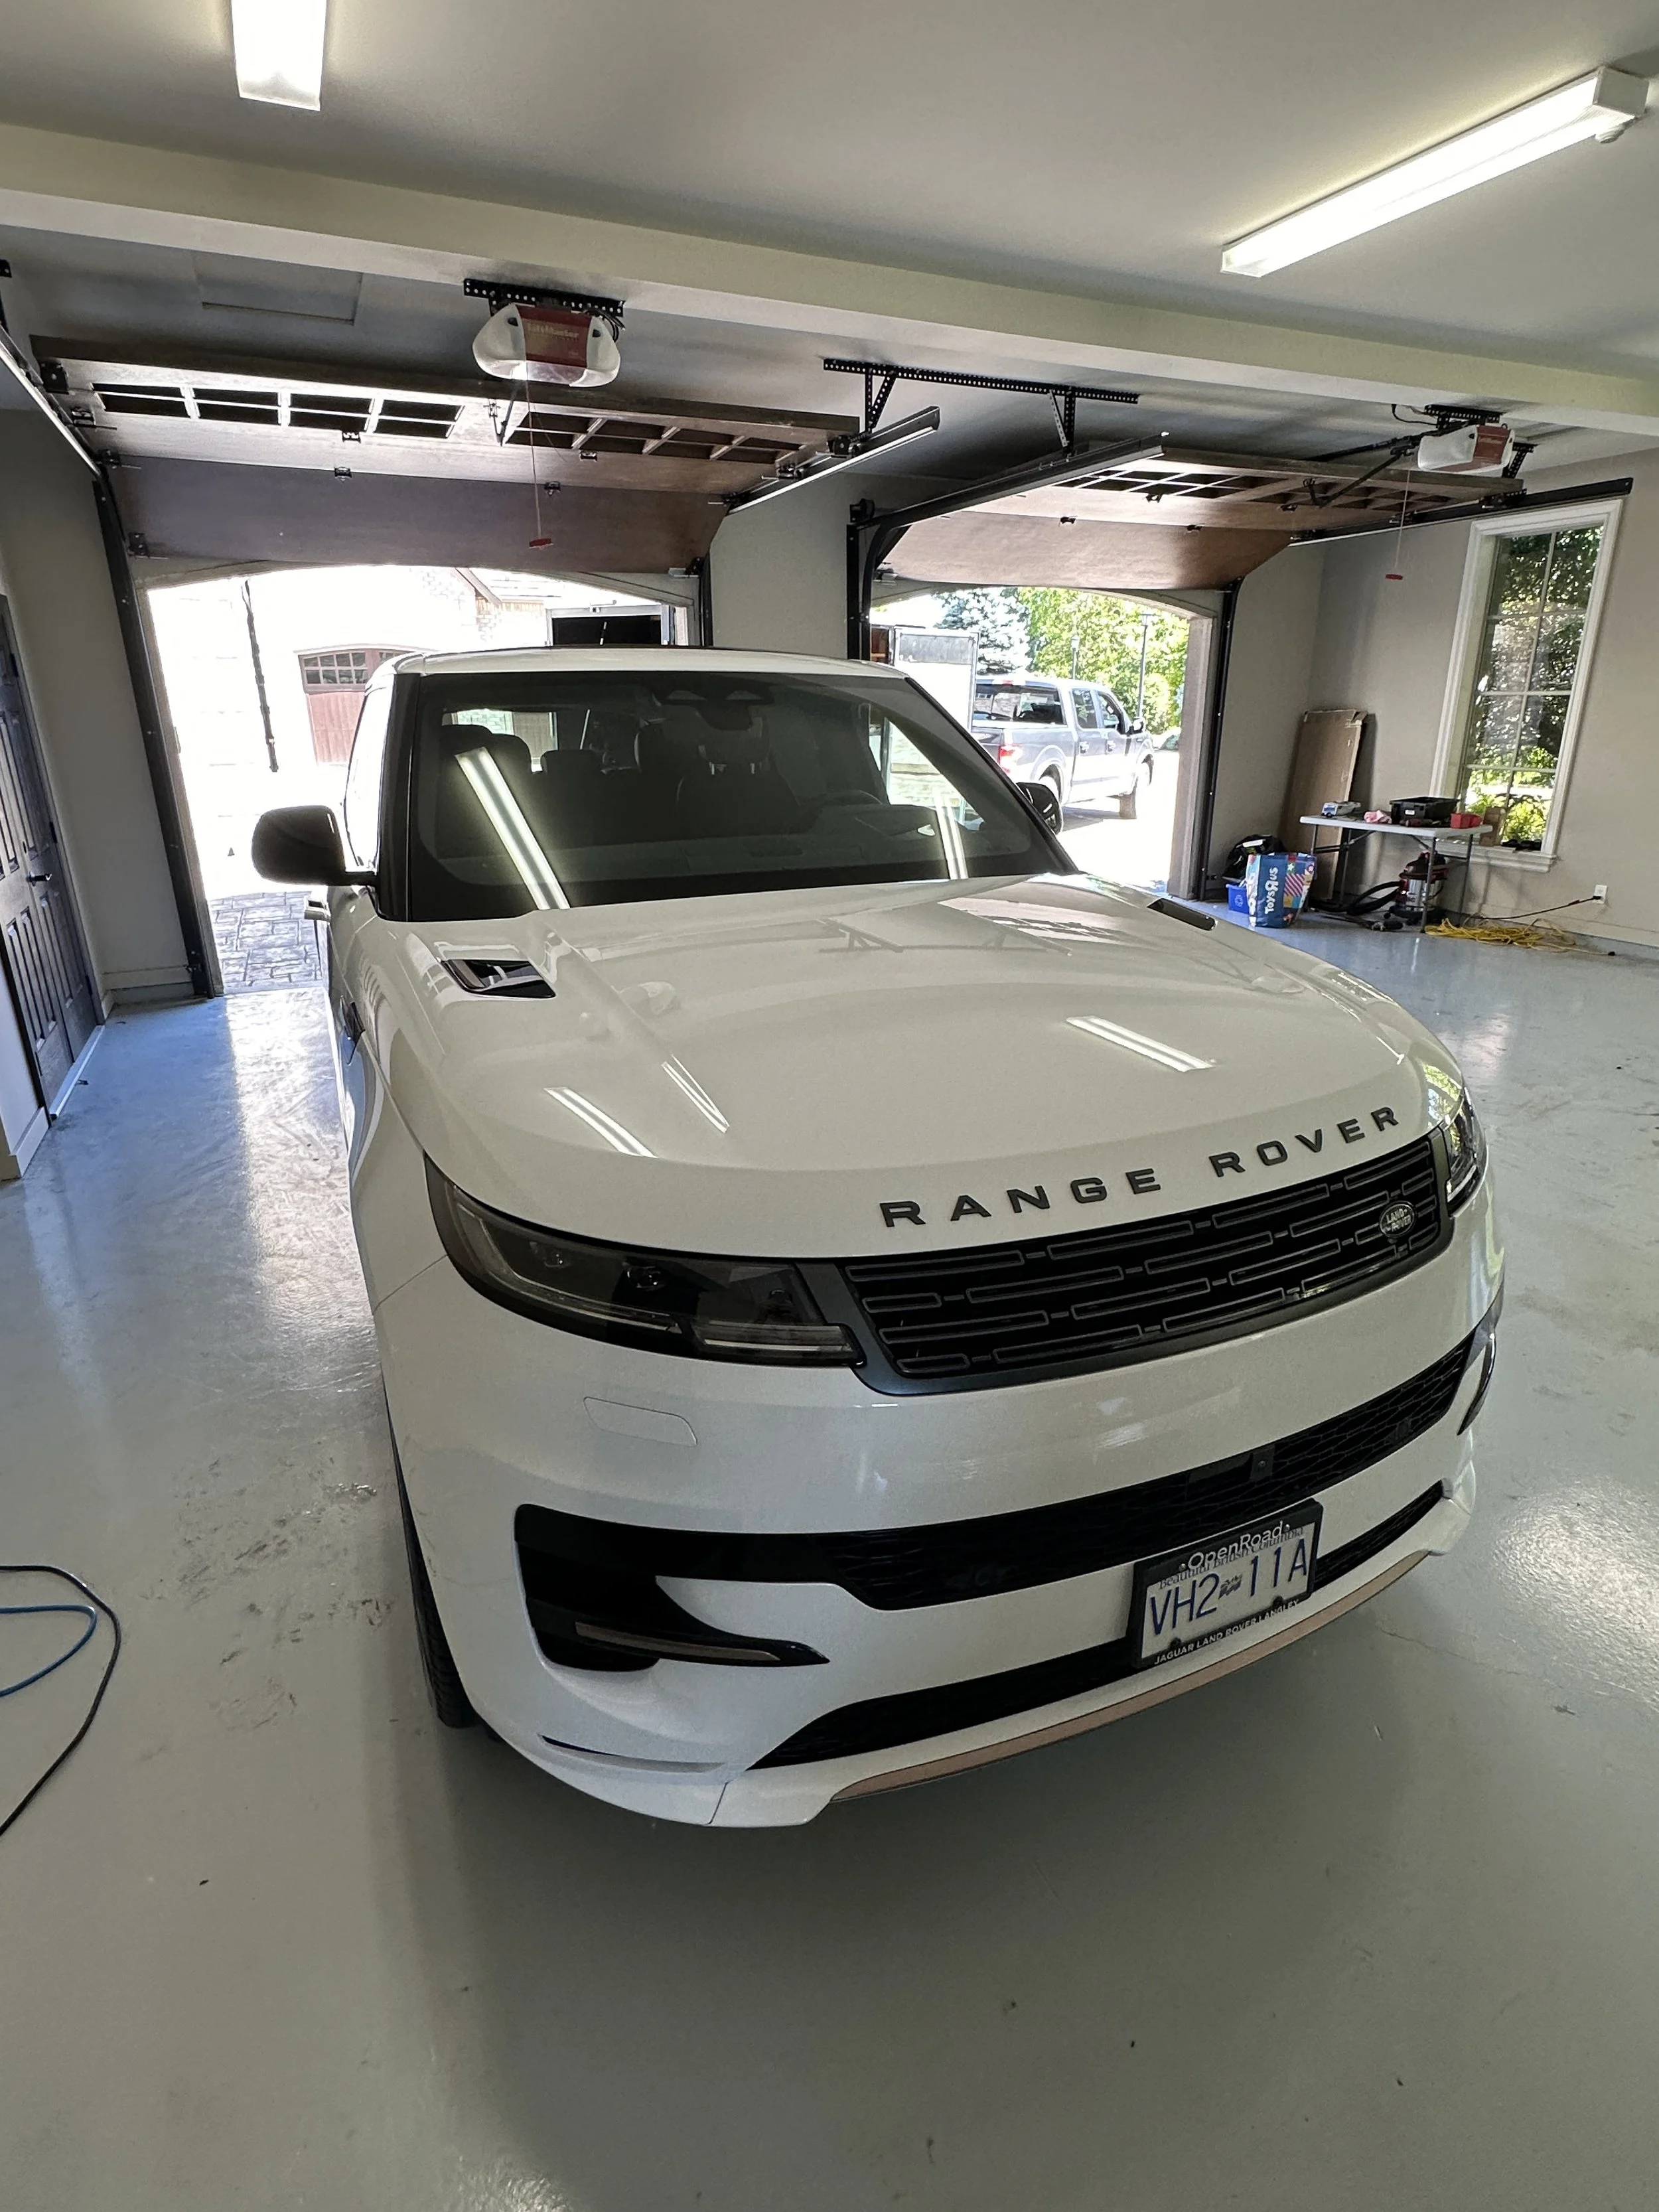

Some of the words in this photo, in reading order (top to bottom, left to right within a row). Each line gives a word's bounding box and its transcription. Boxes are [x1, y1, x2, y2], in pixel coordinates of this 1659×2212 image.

[880, 1169, 1161, 1228] RANGE
[1209, 1107, 1398, 1177] ROVER
[1386, 1208, 1405, 1224] LAND
[1187, 1520, 1283, 1570] OpenRoad
[1149, 1572, 1220, 1636] VH2
[1250, 1538, 1307, 1597] 11A
[1154, 1643, 1194, 1665] JAGUAR
[1196, 1632, 1224, 1647] LAND
[1225, 1618, 1257, 1637] ROVER
[1258, 1598, 1299, 1622] LANGLEY
